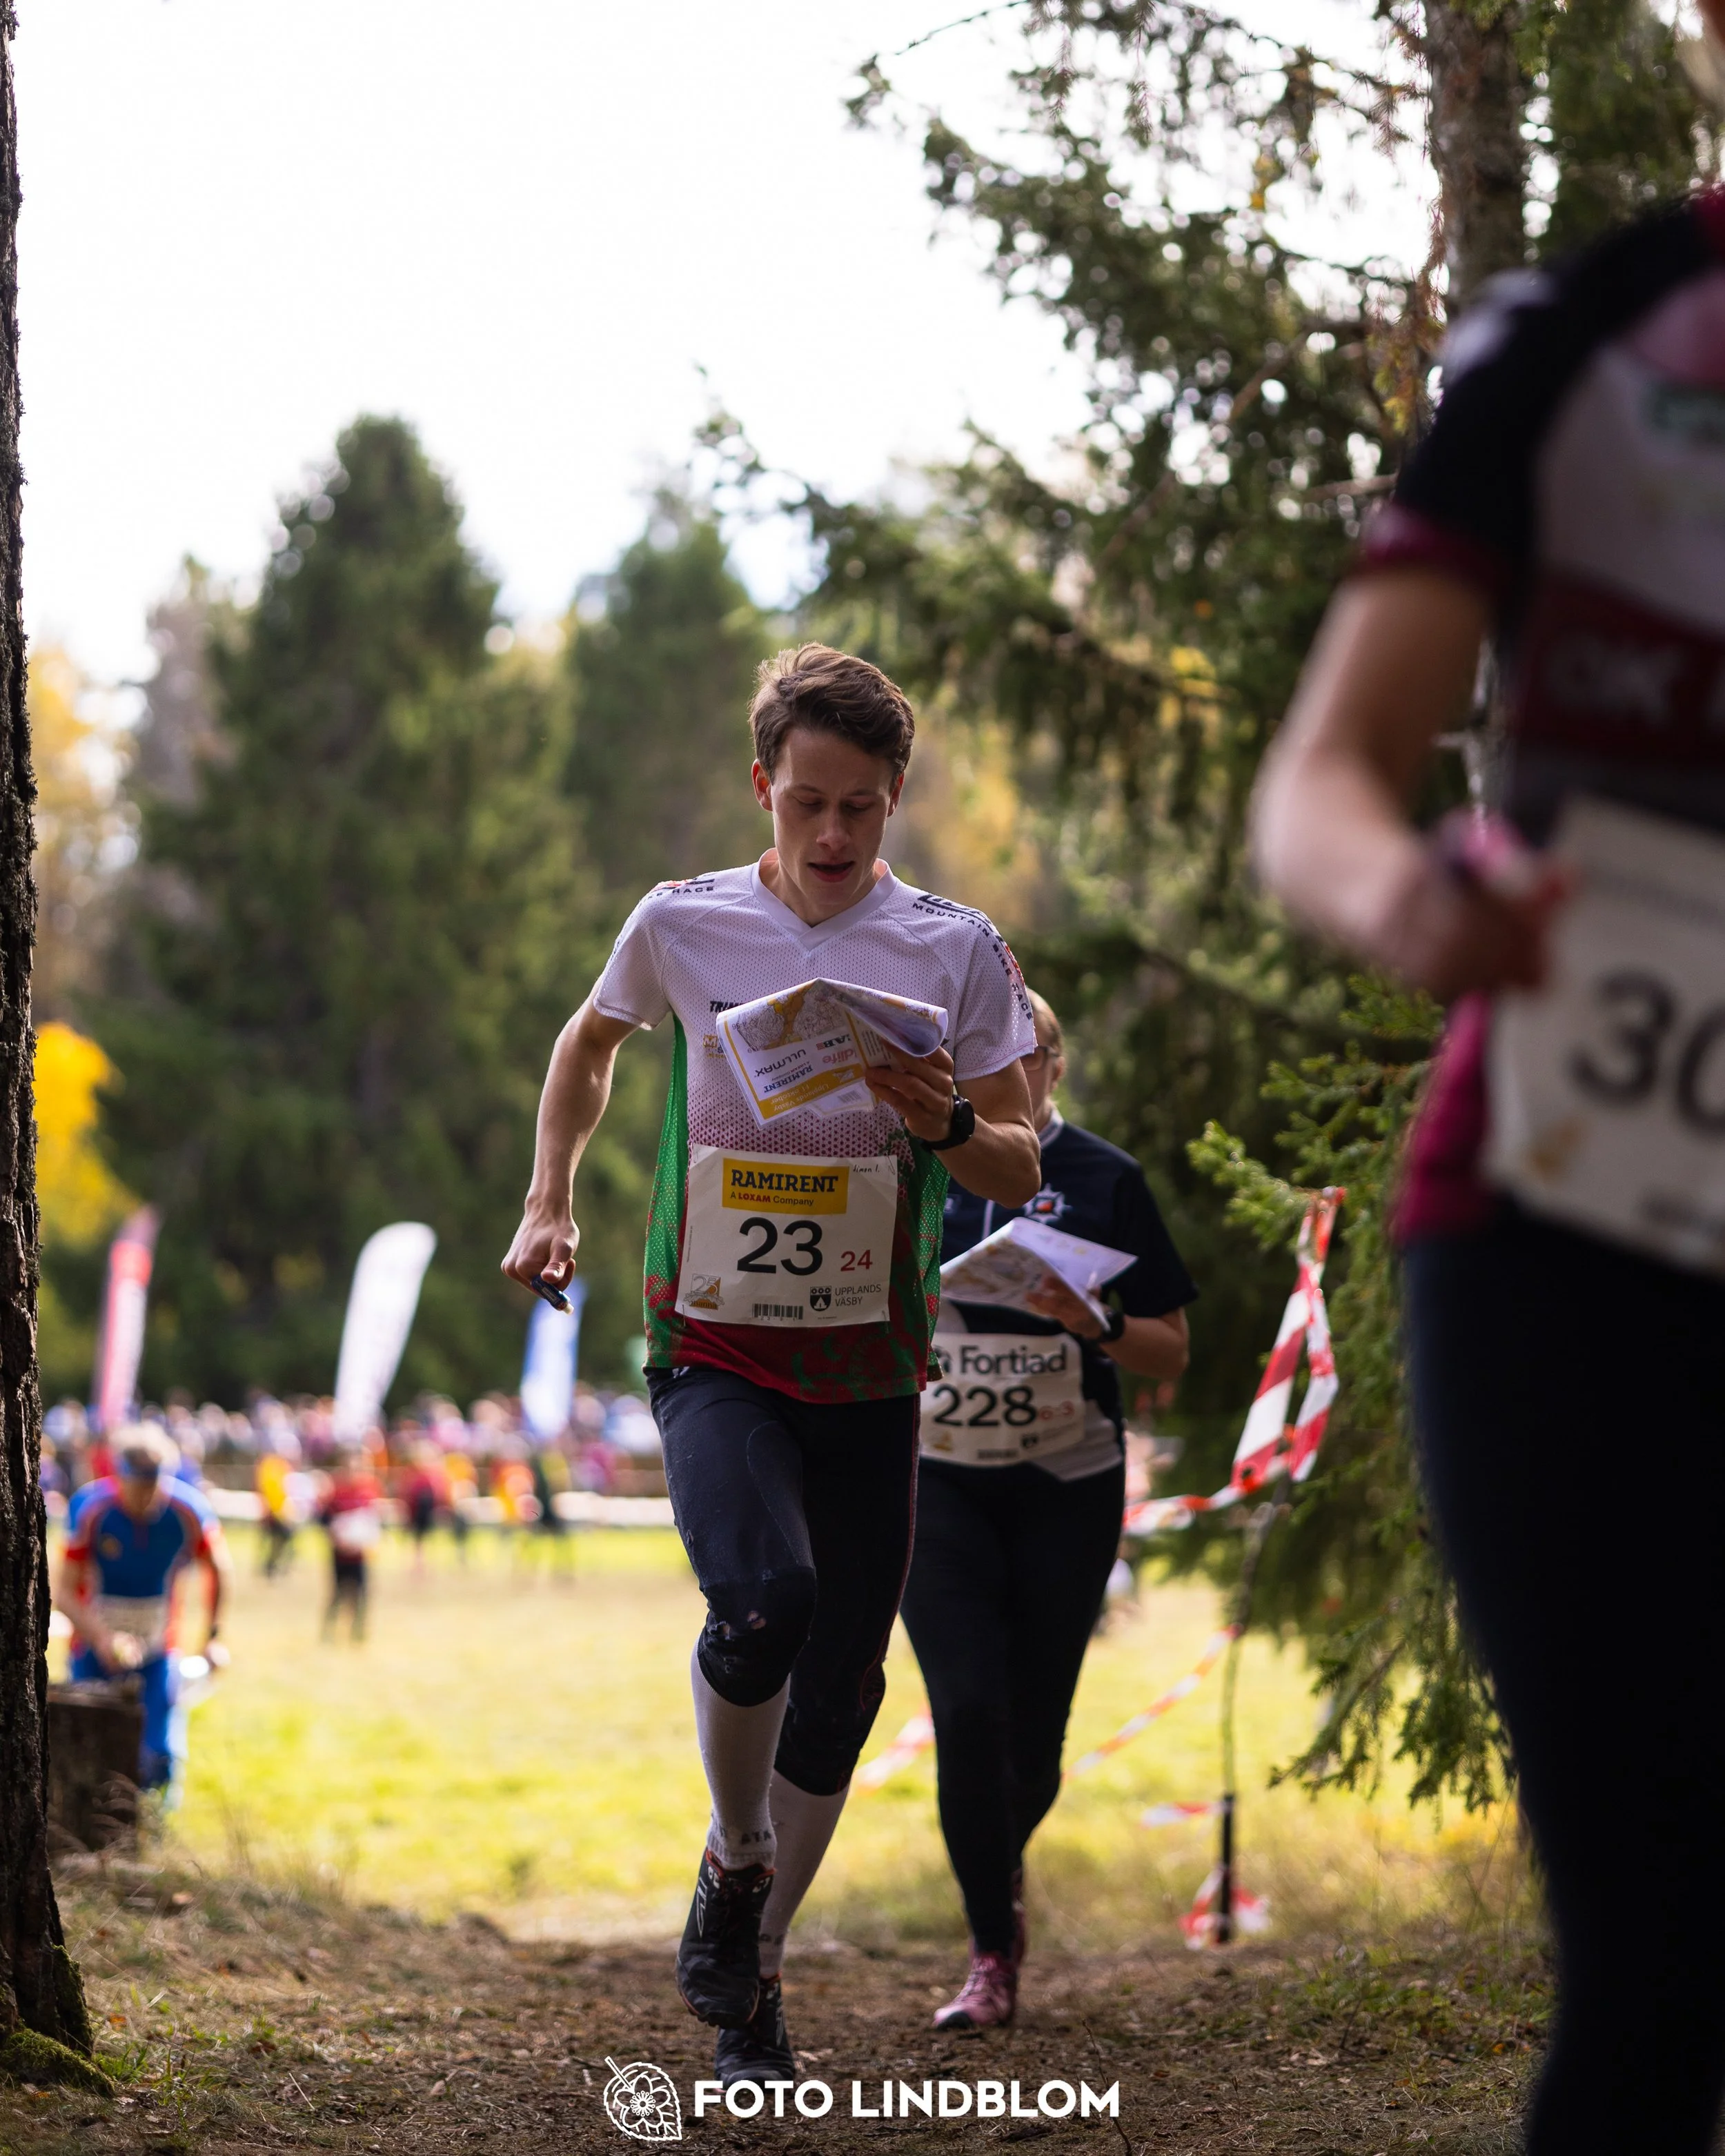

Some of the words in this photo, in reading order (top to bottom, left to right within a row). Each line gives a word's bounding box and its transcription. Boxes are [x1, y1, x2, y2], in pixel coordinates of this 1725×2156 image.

[672, 886, 714, 894] RACE
[912, 903, 989, 937] MOUNTAIN
[992, 943, 1012, 976] BIKE
[1012, 983, 1033, 1020] RACE
[755, 1049, 807, 1076] ULLMAX
[764, 1065, 813, 1093] RAMIRENT
[731, 1169, 838, 1192] RAMIRENT
[738, 1192, 771, 1203] LOXAM
[773, 1195, 814, 1207] Company
[737, 1217, 822, 1276] 23
[840, 1249, 873, 1272] 24
[835, 1284, 882, 1296] UPPLANDS
[835, 1296, 863, 1307] VÄSBY
[960, 1343, 1067, 1374] Fortiad
[933, 1384, 1037, 1427] 228
